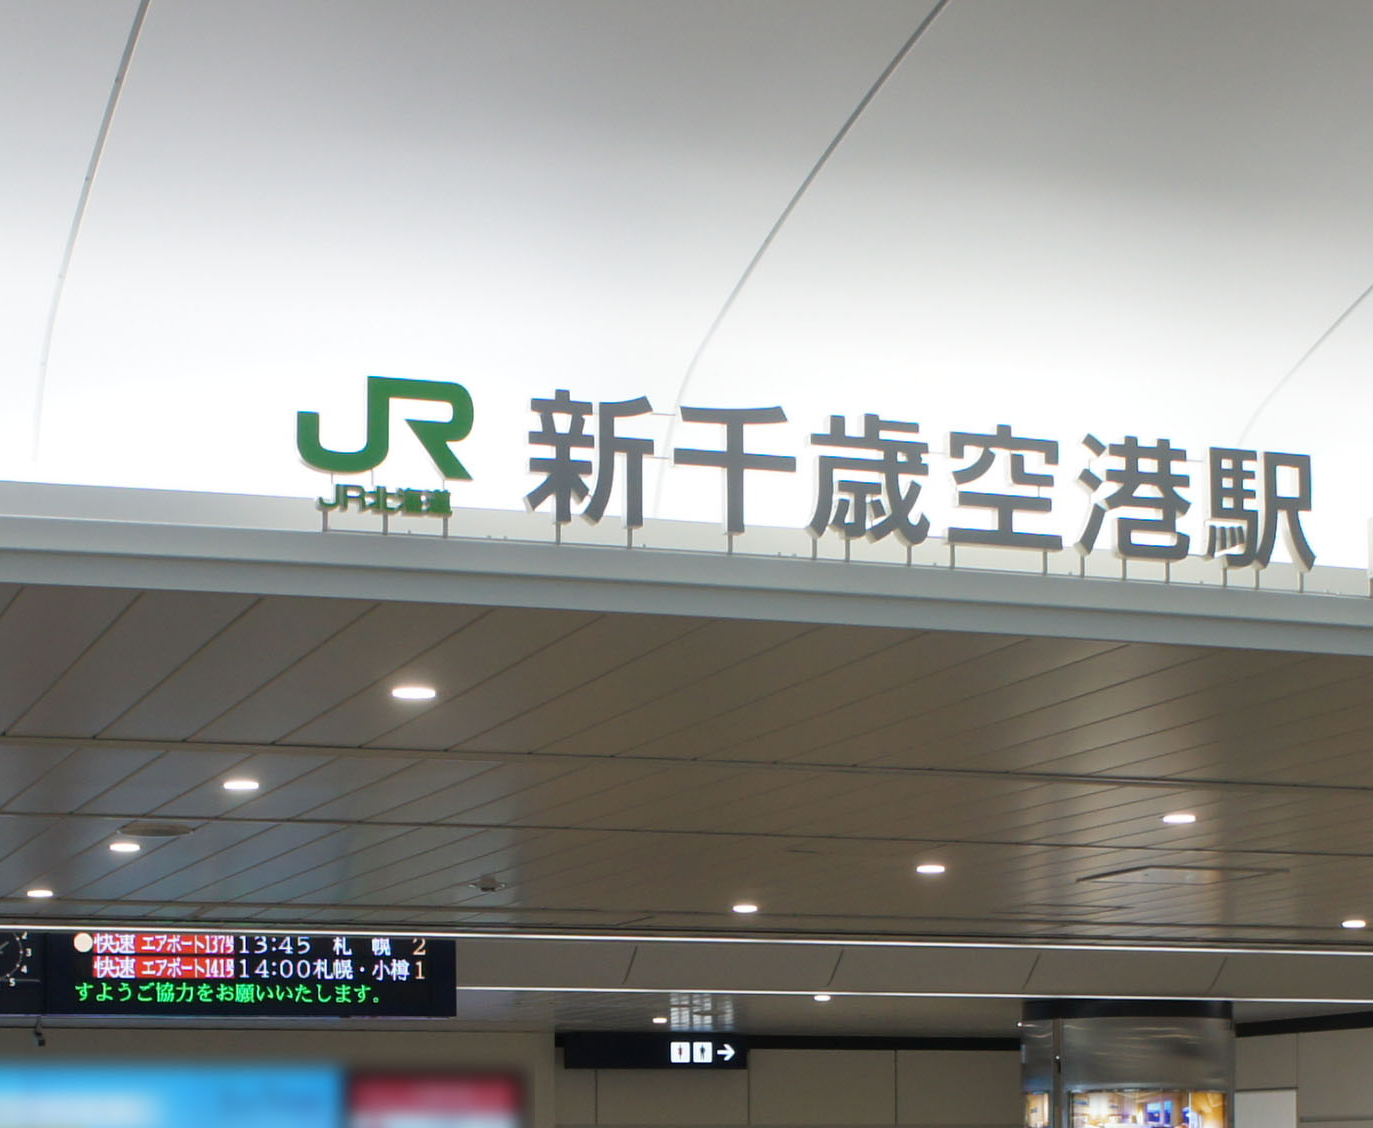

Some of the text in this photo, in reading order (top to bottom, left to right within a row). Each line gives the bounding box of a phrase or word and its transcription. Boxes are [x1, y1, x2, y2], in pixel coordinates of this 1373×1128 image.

[297, 376, 474, 480] JR
[522, 388, 1317, 573] 新千歳空港駅
[25, 948, 32, 957] 3
[94, 933, 136, 954] 快速
[238, 935, 312, 955] 13:45
[412, 937, 427, 956] 2
[20, 964, 28, 974] 4
[94, 956, 136, 979] 快速
[238, 958, 312, 979] 14:00
[414, 960, 427, 980] 1
[9, 977, 16, 987] 5
[74, 981, 381, 1003] すようご協力をお願いいたします。
